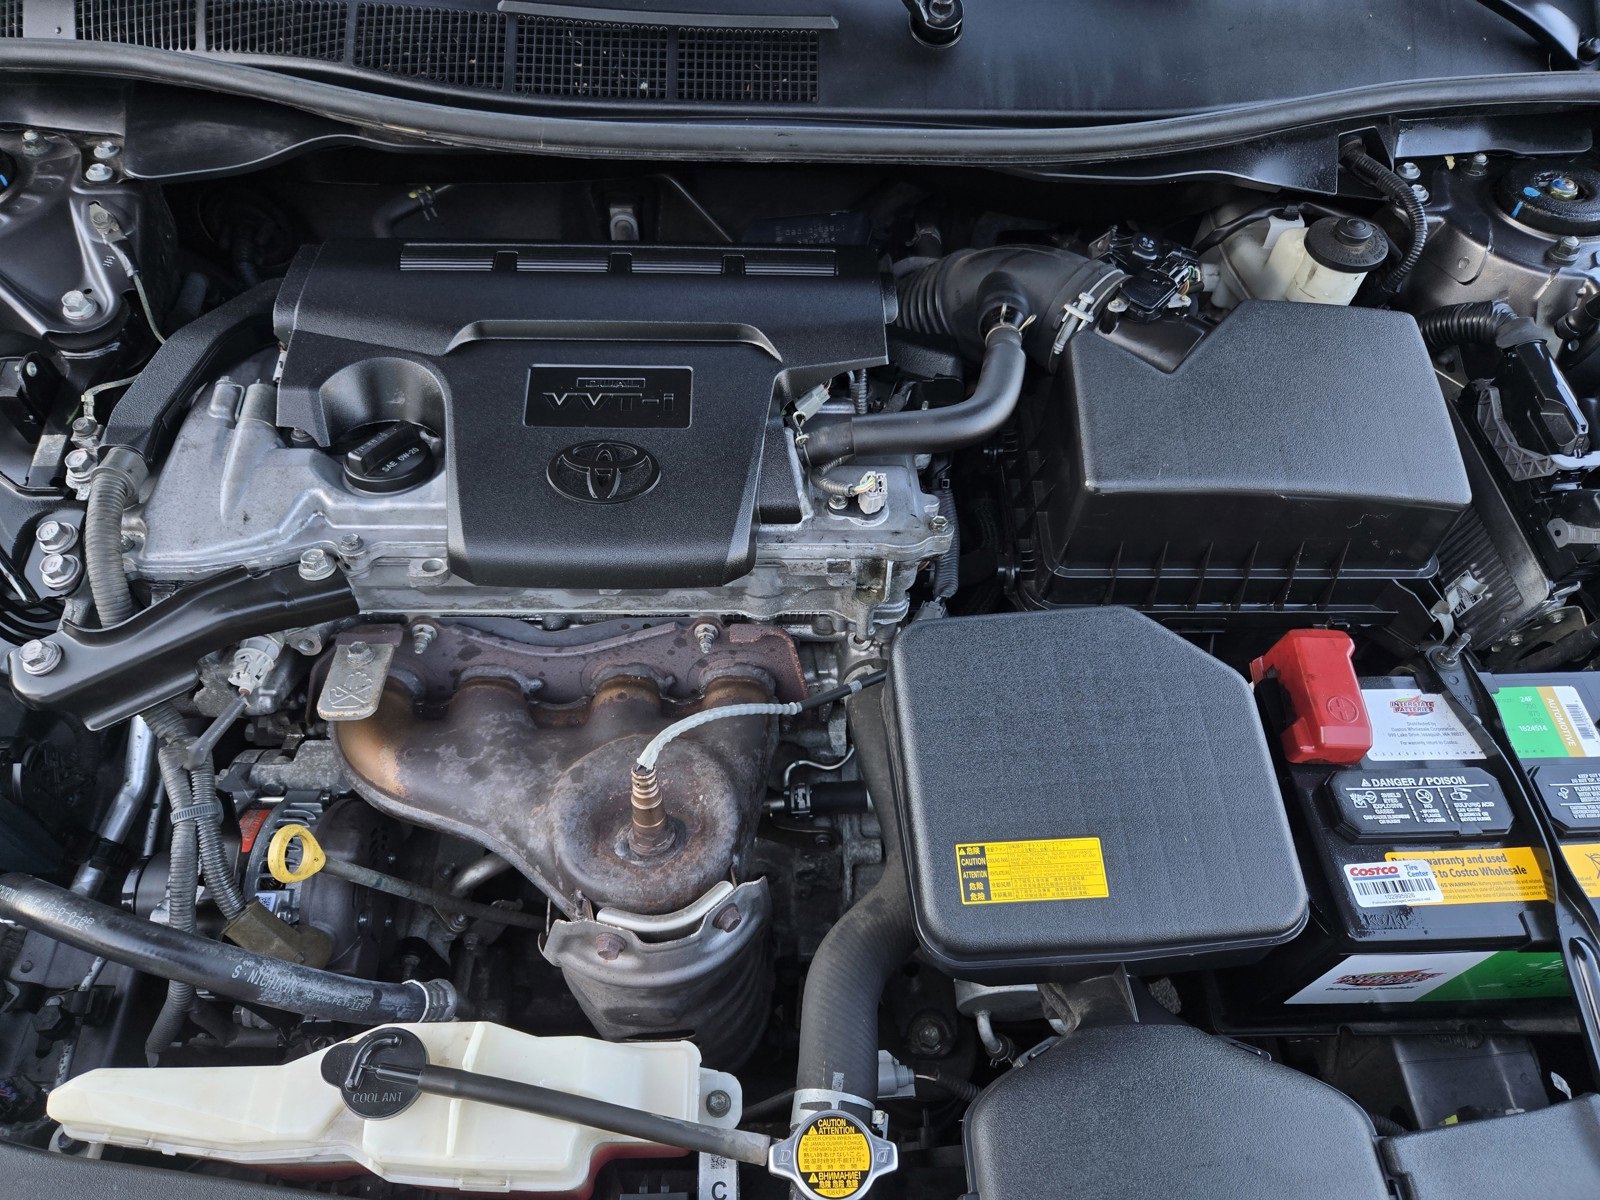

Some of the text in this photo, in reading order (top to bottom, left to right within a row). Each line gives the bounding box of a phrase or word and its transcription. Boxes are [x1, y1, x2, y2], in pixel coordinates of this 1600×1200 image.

[381, 460, 398, 473] SAE
[1546, 698, 1577, 747] AUTOMOTIVE
[1371, 778, 1416, 787] DANGER
[1426, 776, 1467, 785] POISON
[961, 857, 987, 867] CAUTION
[1424, 855, 1465, 867] warranty
[1467, 854, 1484, 864] and
[1486, 853, 1507, 863] used
[962, 871, 988, 879] ATTENTION
[1407, 870, 1429, 878] Center
[1438, 869, 1449, 878] to
[1450, 867, 1479, 879] Costco
[1479, 865, 1528, 877] Wholesale
[352, 1092, 403, 1103] COOLANT
[817, 1118, 847, 1127] CAUTION
[818, 1126, 855, 1135] ATTENTION
[818, 1171, 861, 1181] ВНИМАНИЕ!
[711, 1180, 728, 1200] C
